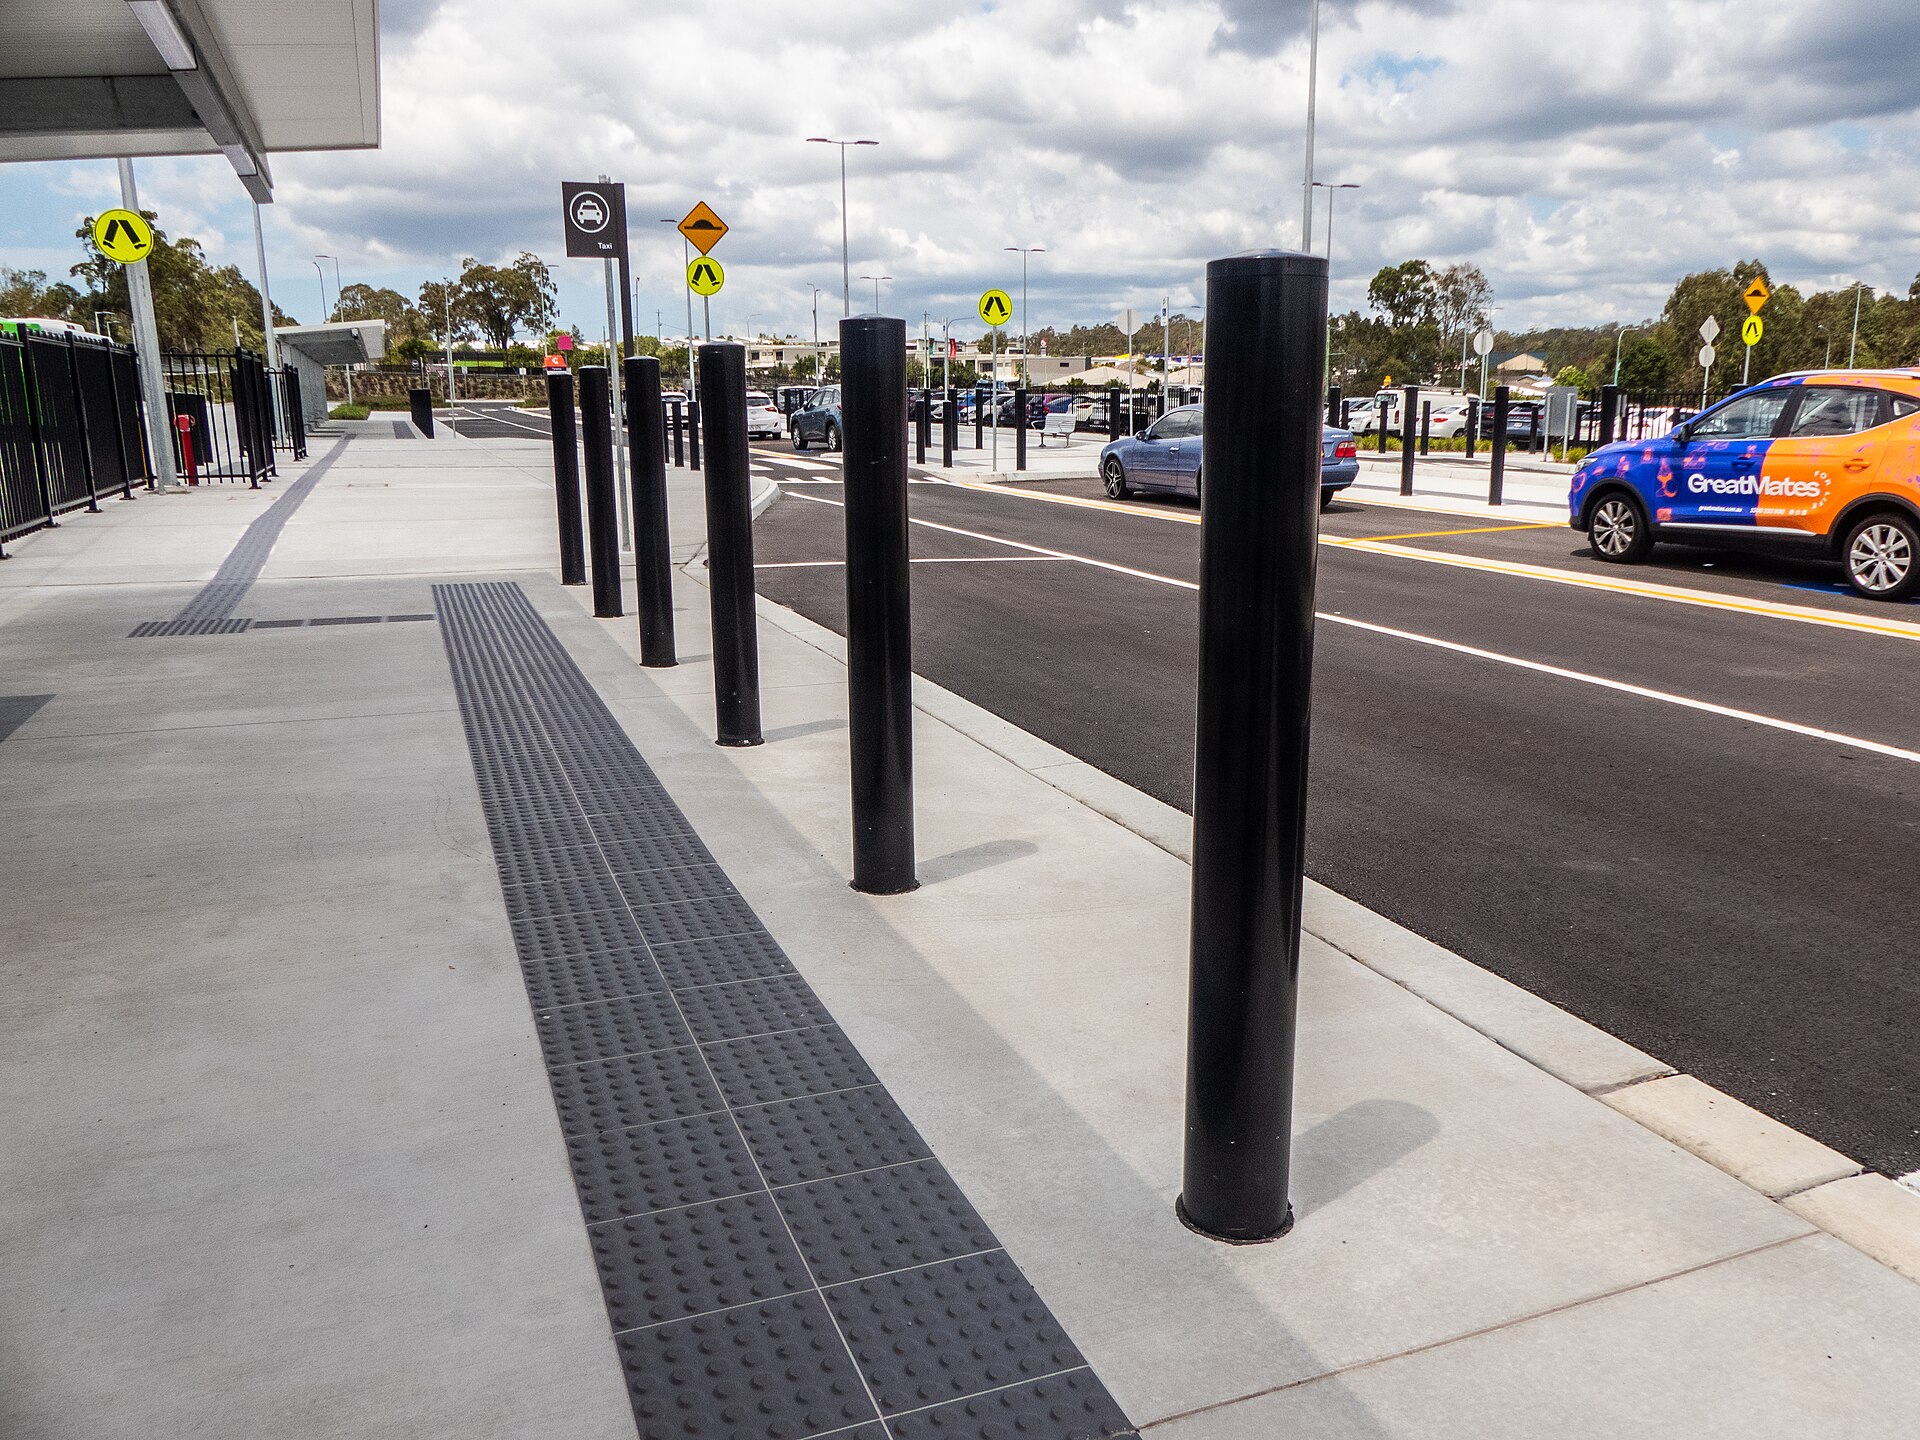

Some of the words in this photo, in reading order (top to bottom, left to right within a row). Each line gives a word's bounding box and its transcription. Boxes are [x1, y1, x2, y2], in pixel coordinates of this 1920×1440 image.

[597, 242, 613, 250] Taxi
[1687, 473, 1820, 497] GreatMates
[1814, 470, 1831, 486] FOR
